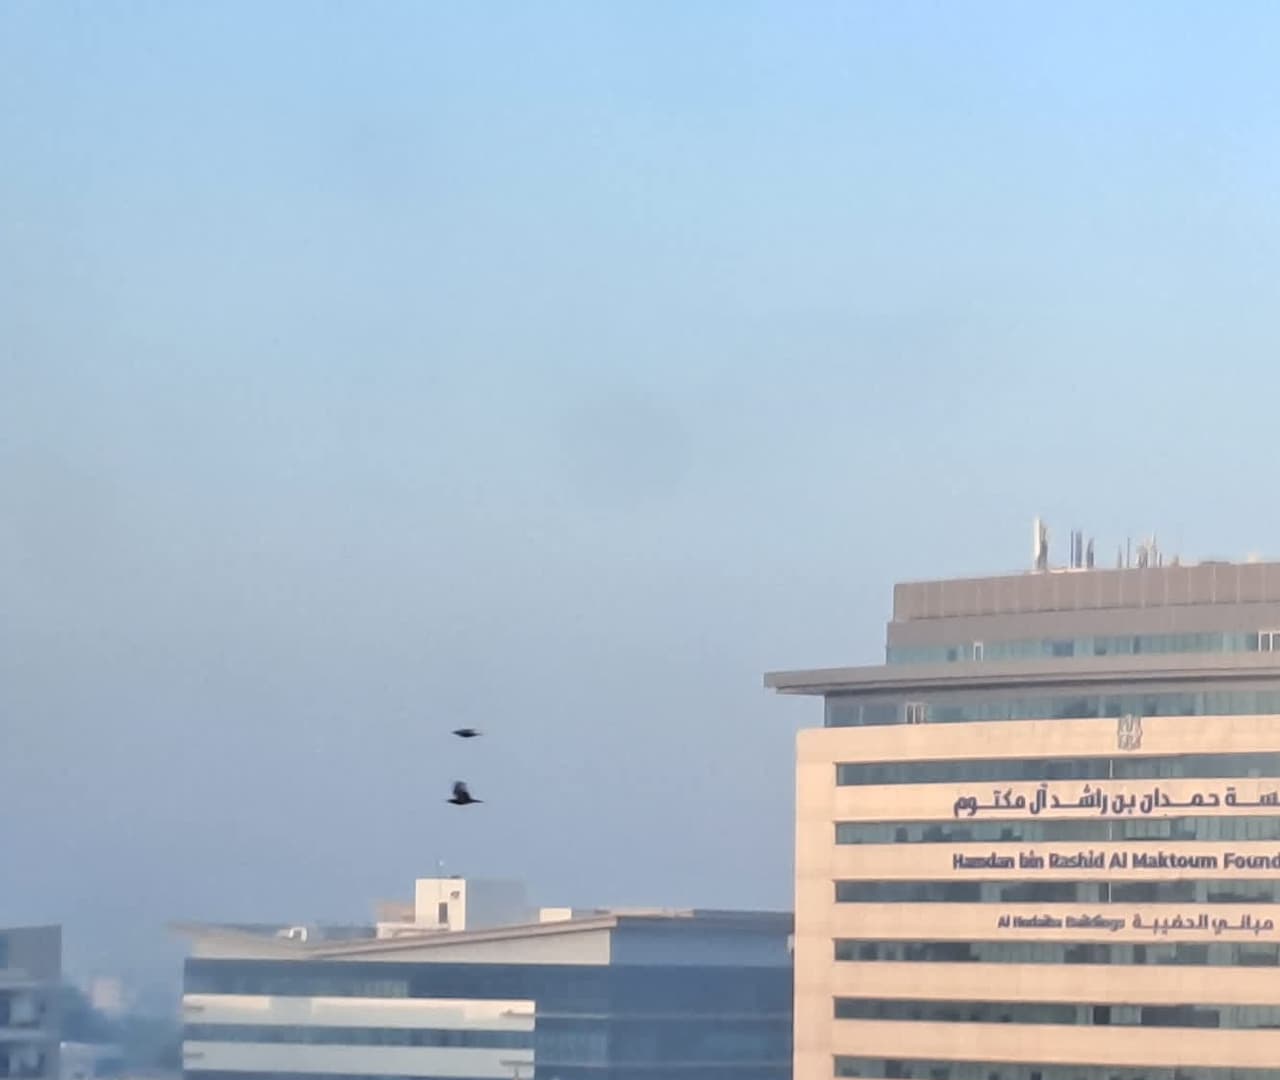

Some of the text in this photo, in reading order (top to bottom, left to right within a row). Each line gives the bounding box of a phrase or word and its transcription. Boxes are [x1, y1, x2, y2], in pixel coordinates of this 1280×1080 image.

[954, 788, 1026, 817] مكتوم
[1051, 783, 1108, 814] راشد
[1112, 793, 1136, 814] بن
[1141, 786, 1220, 814] حمدان
[953, 851, 1014, 869] Hamdan
[1020, 849, 1044, 868] bin
[1049, 849, 1105, 869] Rashid
[1109, 851, 1128, 868] Al
[1132, 850, 1217, 869] Maktoum
[1212, 914, 1274, 935] مباني
